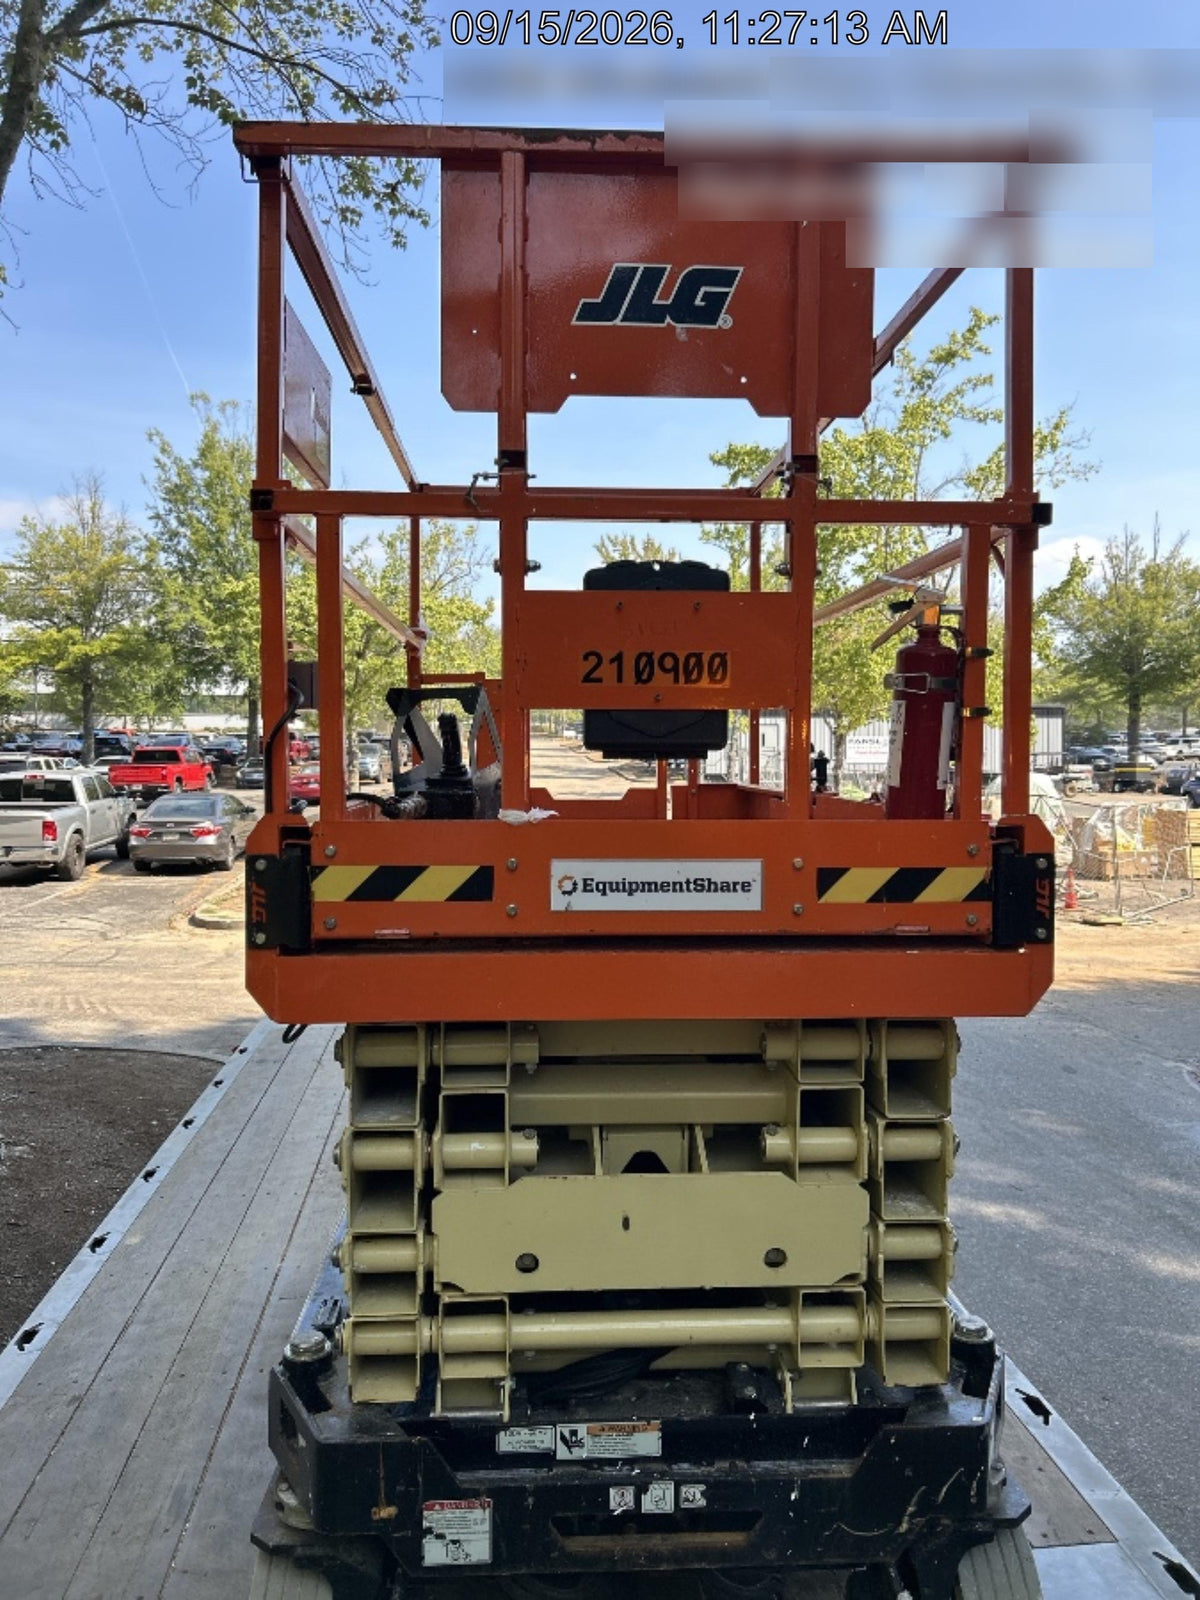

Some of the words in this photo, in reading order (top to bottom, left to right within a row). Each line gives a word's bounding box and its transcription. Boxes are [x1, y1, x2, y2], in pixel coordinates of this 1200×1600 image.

[571, 263, 744, 329] JLG
[581, 651, 728, 685] 210900
[581, 877, 753, 896] EquipmentShare
